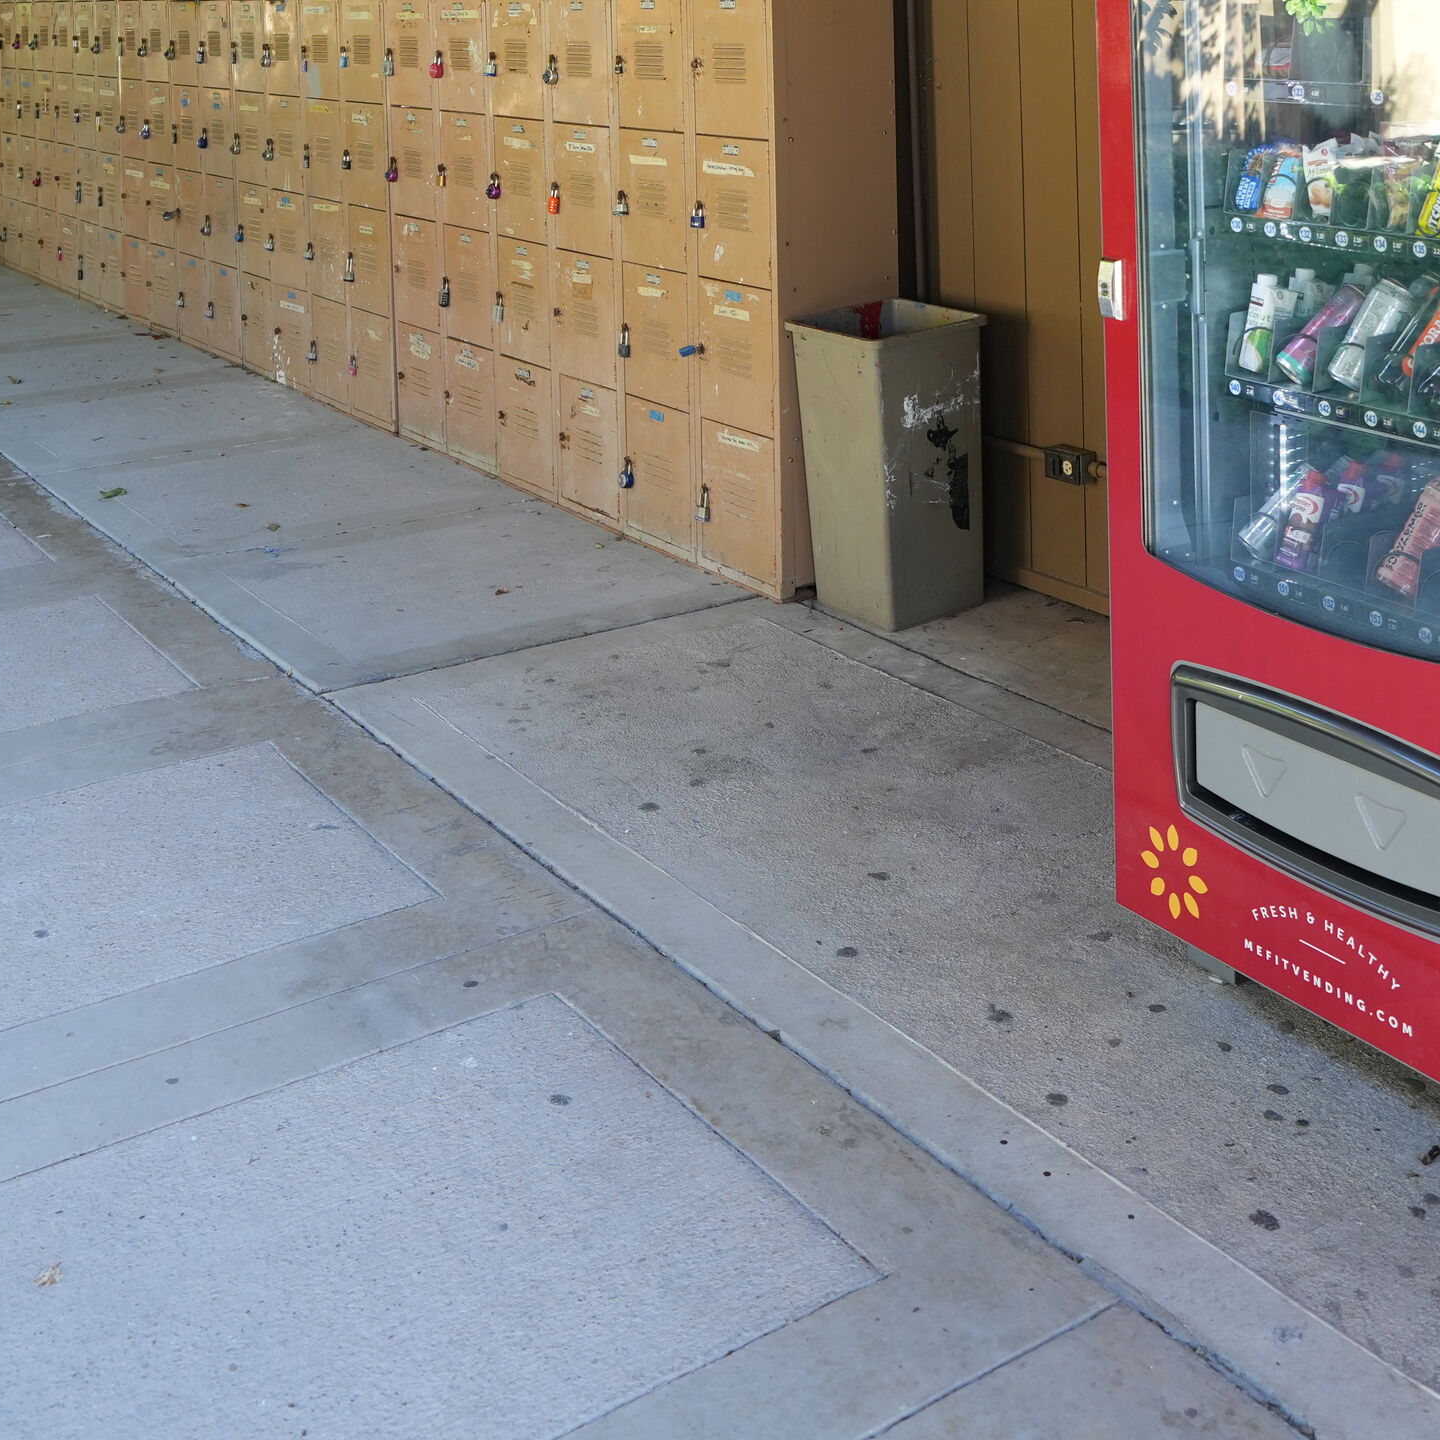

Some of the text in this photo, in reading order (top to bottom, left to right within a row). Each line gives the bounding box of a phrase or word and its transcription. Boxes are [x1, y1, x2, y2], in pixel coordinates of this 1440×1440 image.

[1293, 87, 1304, 97] 123
[1299, 229, 1311, 239] 132
[1335, 234, 1348, 244] 133
[1374, 239, 1386, 249] 134
[1413, 244, 1425, 255] 135
[1319, 403, 1331, 414] 142
[1364, 413, 1377, 423] 143
[1414, 425, 1426, 435] 144
[1278, 583, 1289, 594] 151
[1323, 597, 1334, 609] 152
[1370, 613, 1382, 624] 153
[1251, 905, 1401, 990] FRESH & HEALTHY
[1244, 938, 1413, 1037] MEFITVENDING.COM
